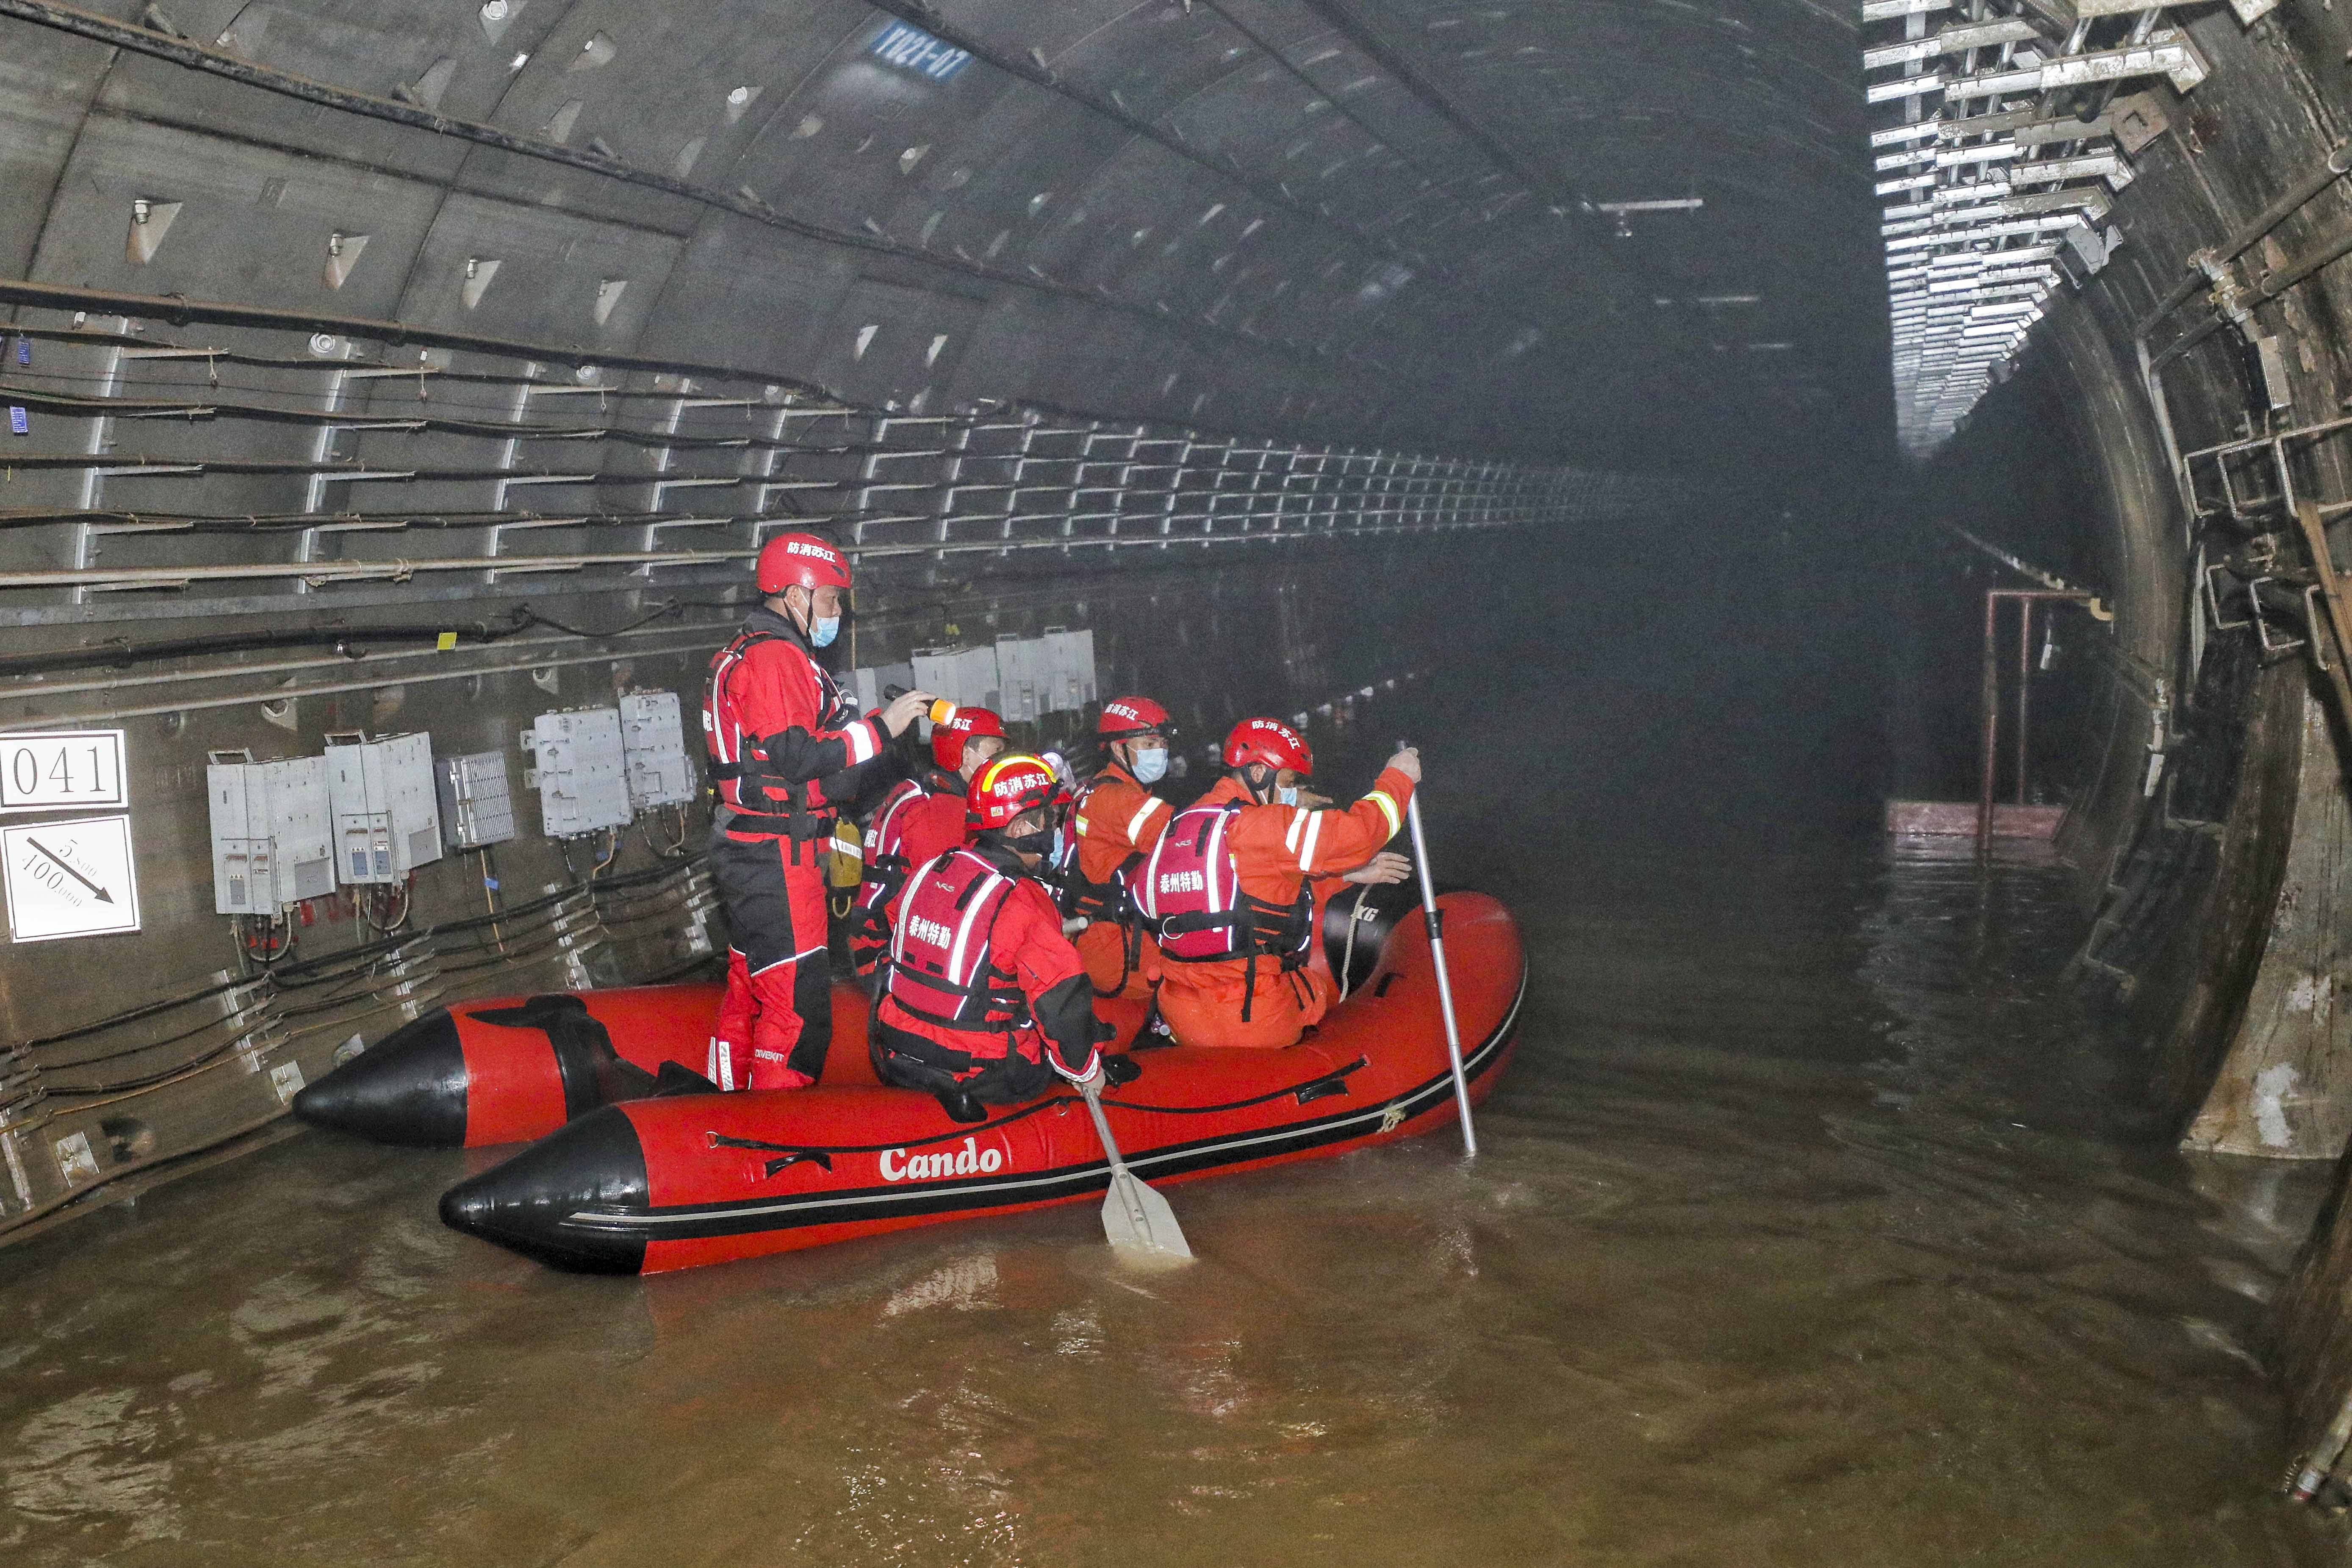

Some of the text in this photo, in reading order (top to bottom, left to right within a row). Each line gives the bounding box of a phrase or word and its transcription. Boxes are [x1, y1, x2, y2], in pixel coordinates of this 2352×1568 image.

[14, 746, 106, 794] 041
[1160, 870, 1203, 894] 泰州特勤
[909, 915, 951, 949] 泰州特勤
[879, 1137, 1002, 1181] Cando
